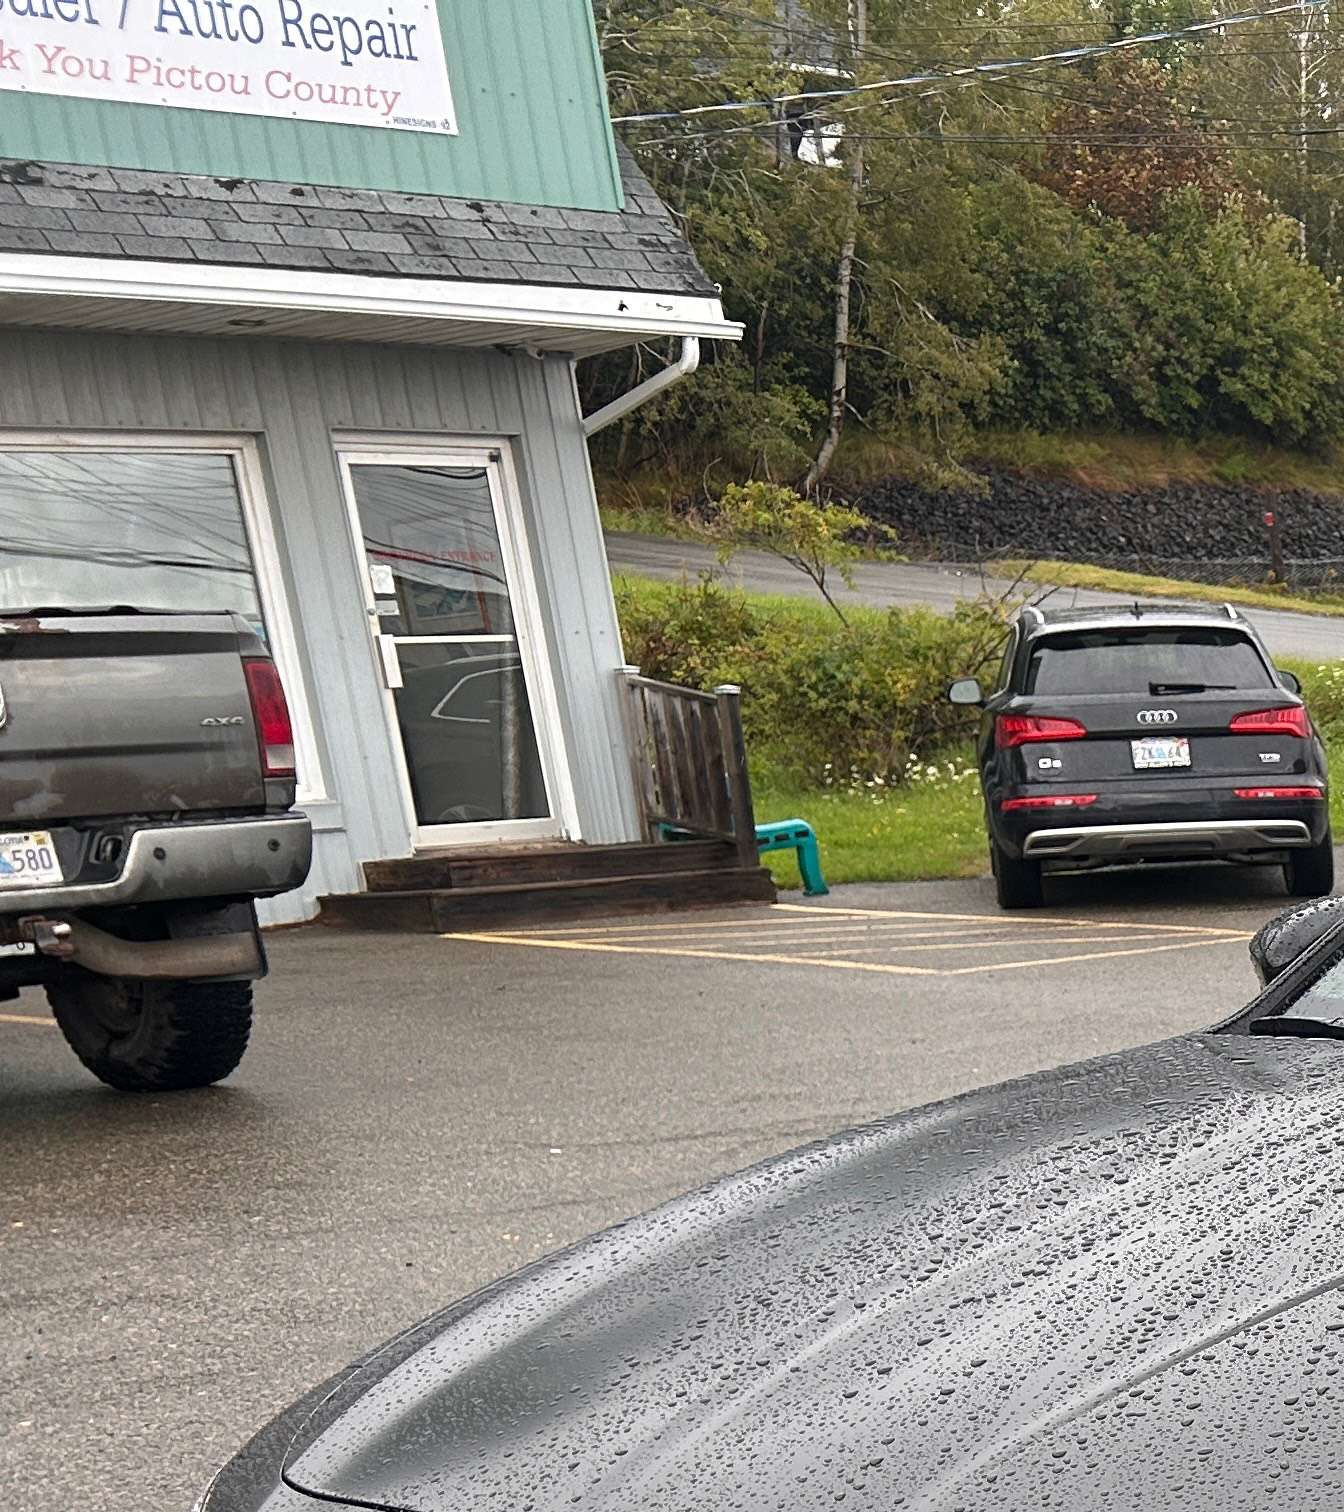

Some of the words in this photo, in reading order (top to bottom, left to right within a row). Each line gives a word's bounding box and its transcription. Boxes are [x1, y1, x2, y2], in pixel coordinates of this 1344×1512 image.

[154, 0, 265, 44] Auto
[279, 0, 418, 67] Repair
[35, 43, 111, 81] You
[126, 53, 251, 96] Pictou
[265, 69, 401, 116] County
[11, 847, 53, 873] 580
